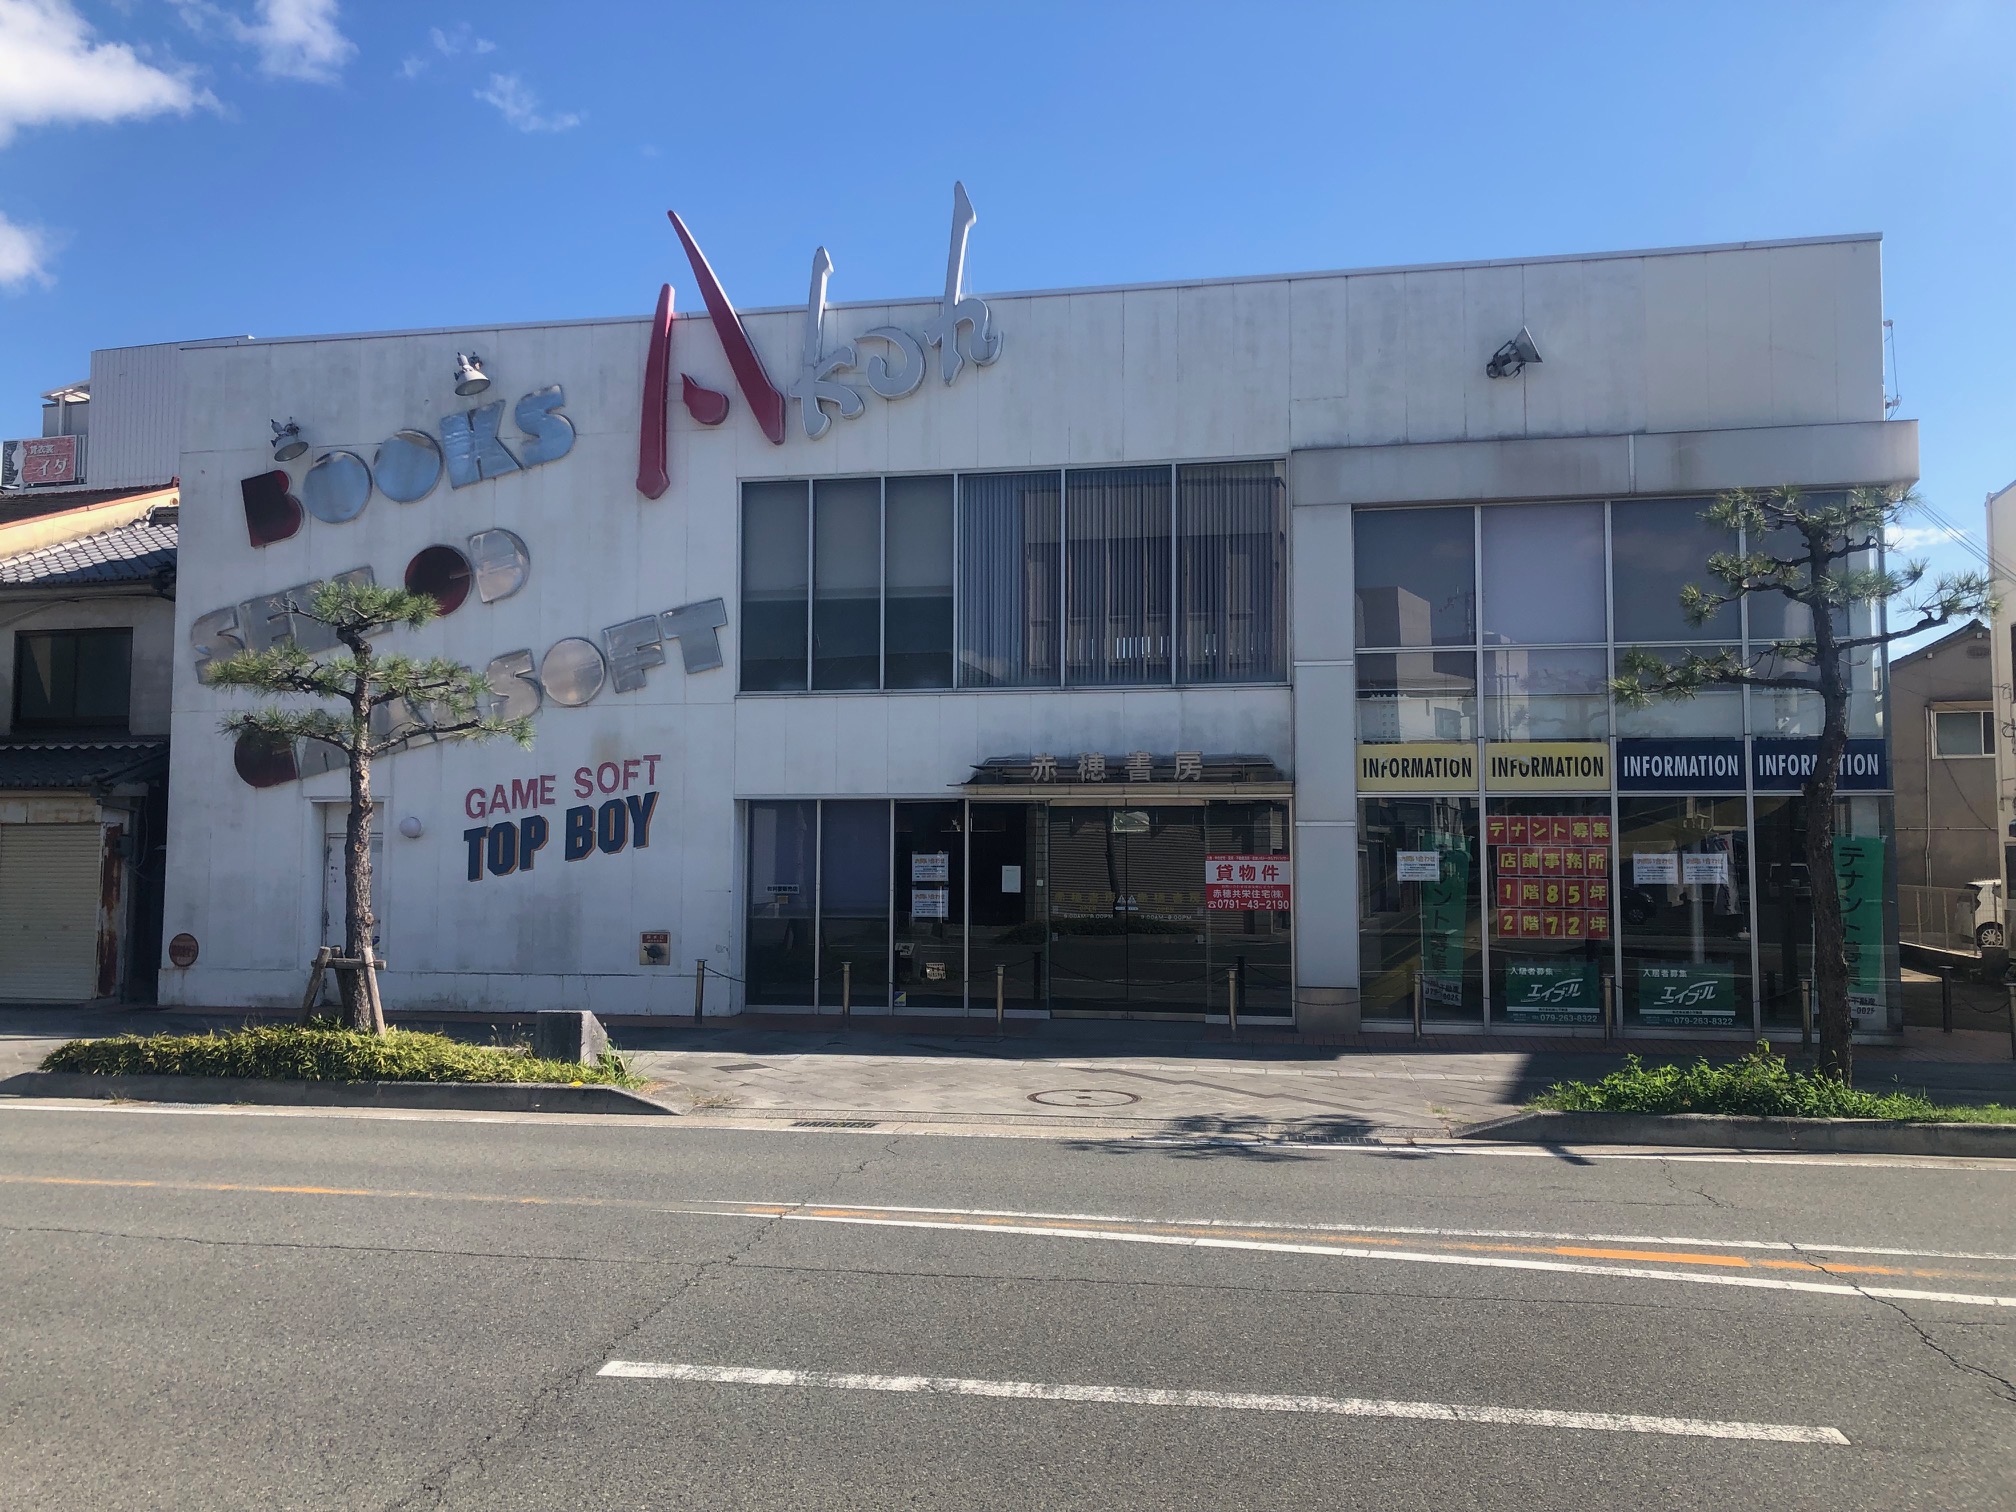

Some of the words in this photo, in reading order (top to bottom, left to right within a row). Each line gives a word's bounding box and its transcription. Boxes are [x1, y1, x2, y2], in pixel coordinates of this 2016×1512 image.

[241, 384, 577, 549] BOOKS
[486, 597, 728, 726] SOFT
[1030, 750, 1204, 783] 赤穂書房
[1362, 757, 1473, 779] INFORMATION
[1491, 755, 1605, 779] INFORMATION
[1623, 754, 1740, 778] INFORMATION
[1758, 753, 1880, 777] INFORTION
[465, 774, 557, 820] GAME
[573, 753, 662, 800] SOFT
[463, 814, 550, 883] TOP
[564, 790, 661, 863] BOY
[1489, 822, 1610, 838] テナント募集
[1501, 852, 1605, 869] 店舗事務所
[1216, 864, 1280, 882] 貸物件
[1505, 884, 1606, 904] 1階85坪
[1503, 915, 1607, 935] 2階72坪
[1510, 966, 1554, 976] 入居者募集
[1643, 969, 1688, 978] 入居者募集
